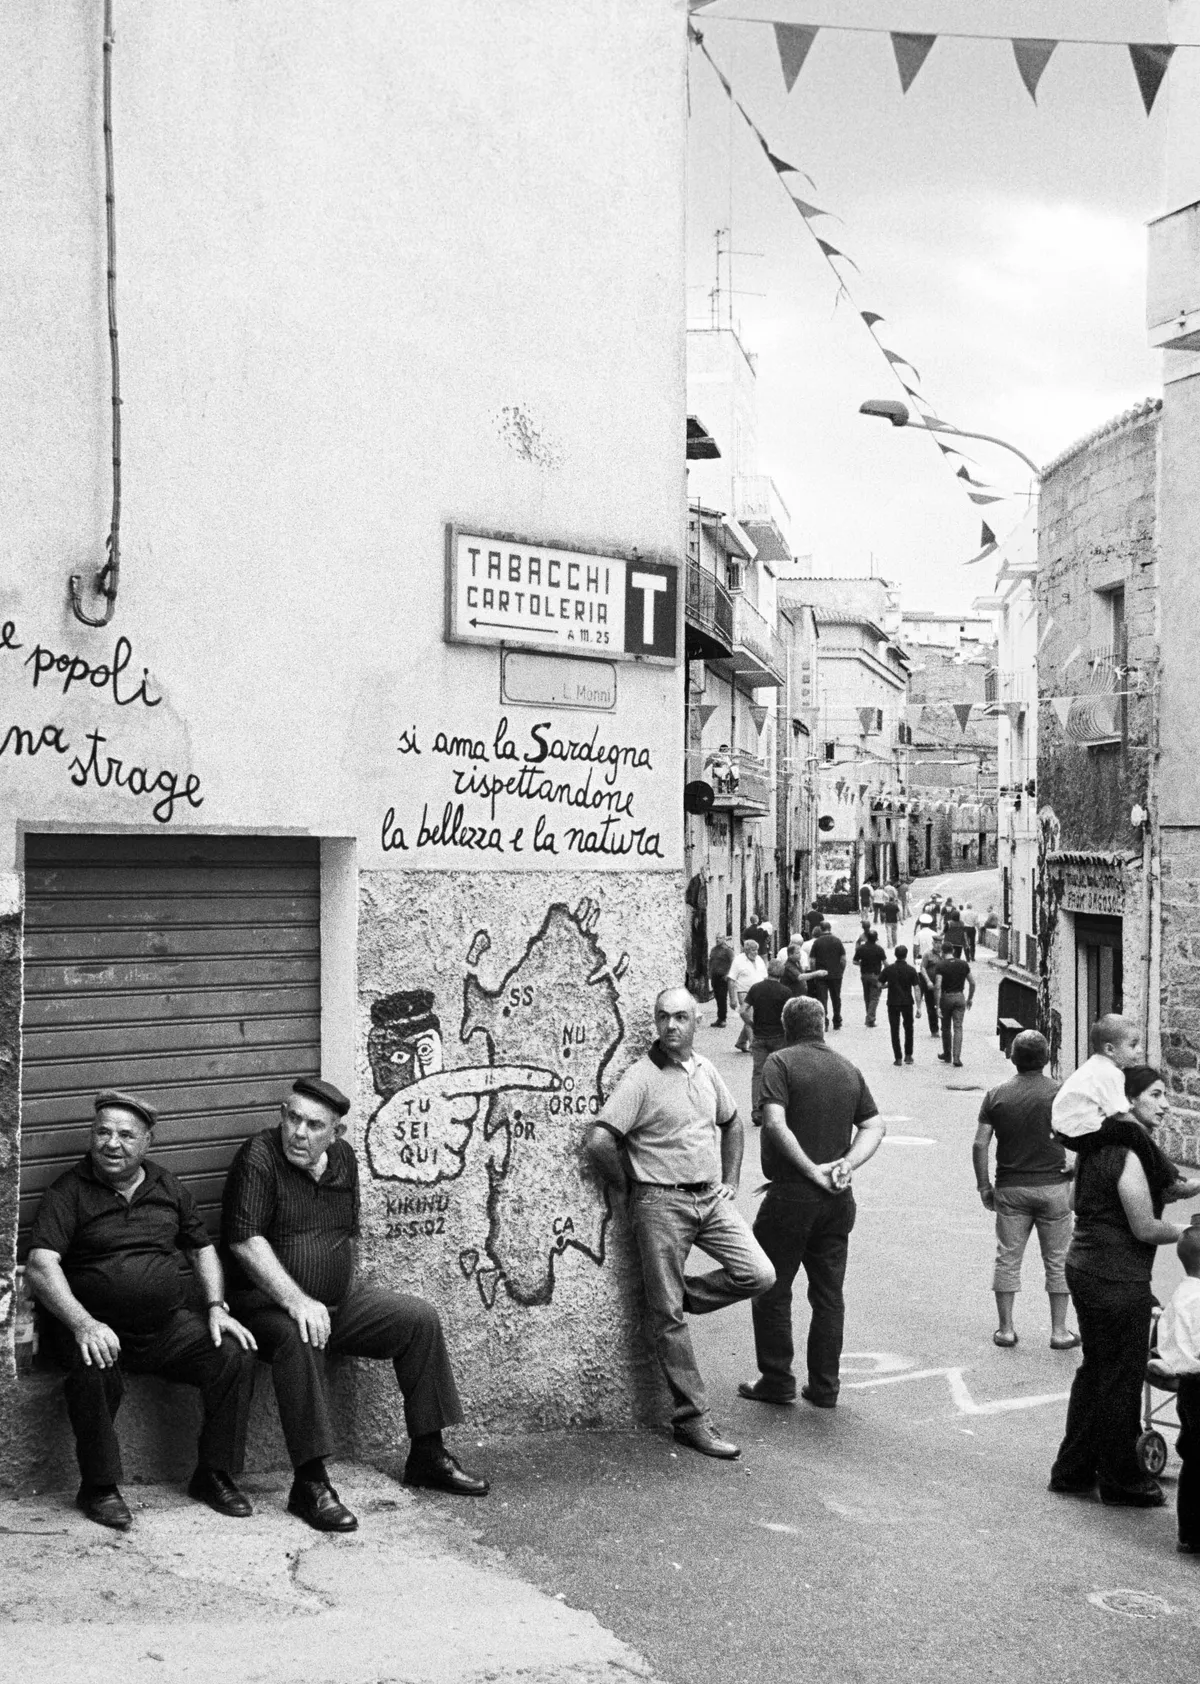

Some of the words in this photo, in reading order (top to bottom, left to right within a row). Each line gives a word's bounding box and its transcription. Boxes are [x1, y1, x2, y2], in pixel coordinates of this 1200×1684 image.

[467, 547, 610, 595] TABACCHI
[466, 585, 608, 625] CARTOLERIA
[631, 571, 668, 645] T
[567, 629, 575, 640] A
[596, 630, 610, 645] 25
[24, 636, 163, 707] popoli
[397, 724, 422, 755] si
[432, 732, 490, 762] ama
[492, 716, 520, 762] la
[523, 722, 653, 785] Sardegna
[0, 724, 71, 756] na
[67, 728, 205, 824] strage
[452, 764, 635, 821] rispettandone
[381, 806, 410, 852] la
[416, 800, 505, 853] bellezza
[509, 827, 524, 852] e
[533, 814, 560, 855] la
[564, 813, 665, 858] natura
[509, 984, 535, 1007] SS
[562, 1022, 586, 1046] NU
[402, 1098, 431, 1117] TU
[549, 1093, 610, 1116] ORGO
[394, 1120, 429, 1141] SEI
[513, 1120, 536, 1141] OR
[400, 1143, 438, 1168] QUI
[552, 1216, 575, 1236] CA
